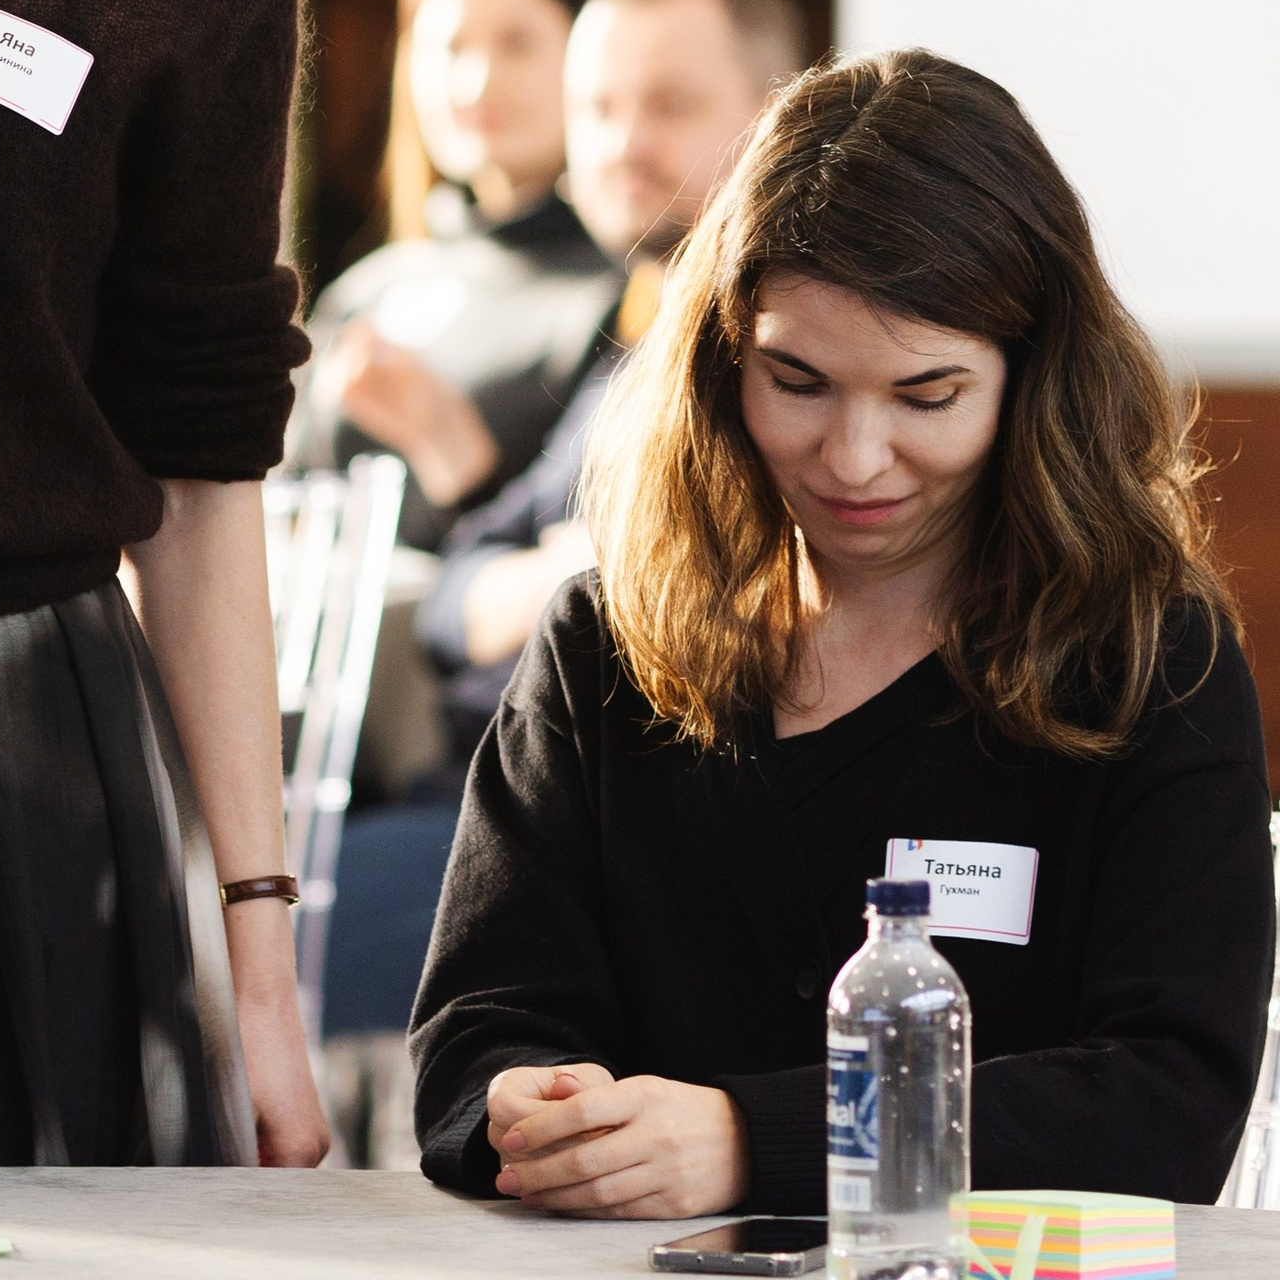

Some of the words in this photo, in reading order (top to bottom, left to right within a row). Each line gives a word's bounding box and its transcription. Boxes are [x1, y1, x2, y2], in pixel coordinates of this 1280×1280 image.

[0, 32, 36, 56] Яна
[924, 859, 1002, 879] Татьяна
[940, 884, 980, 896] Гухман
